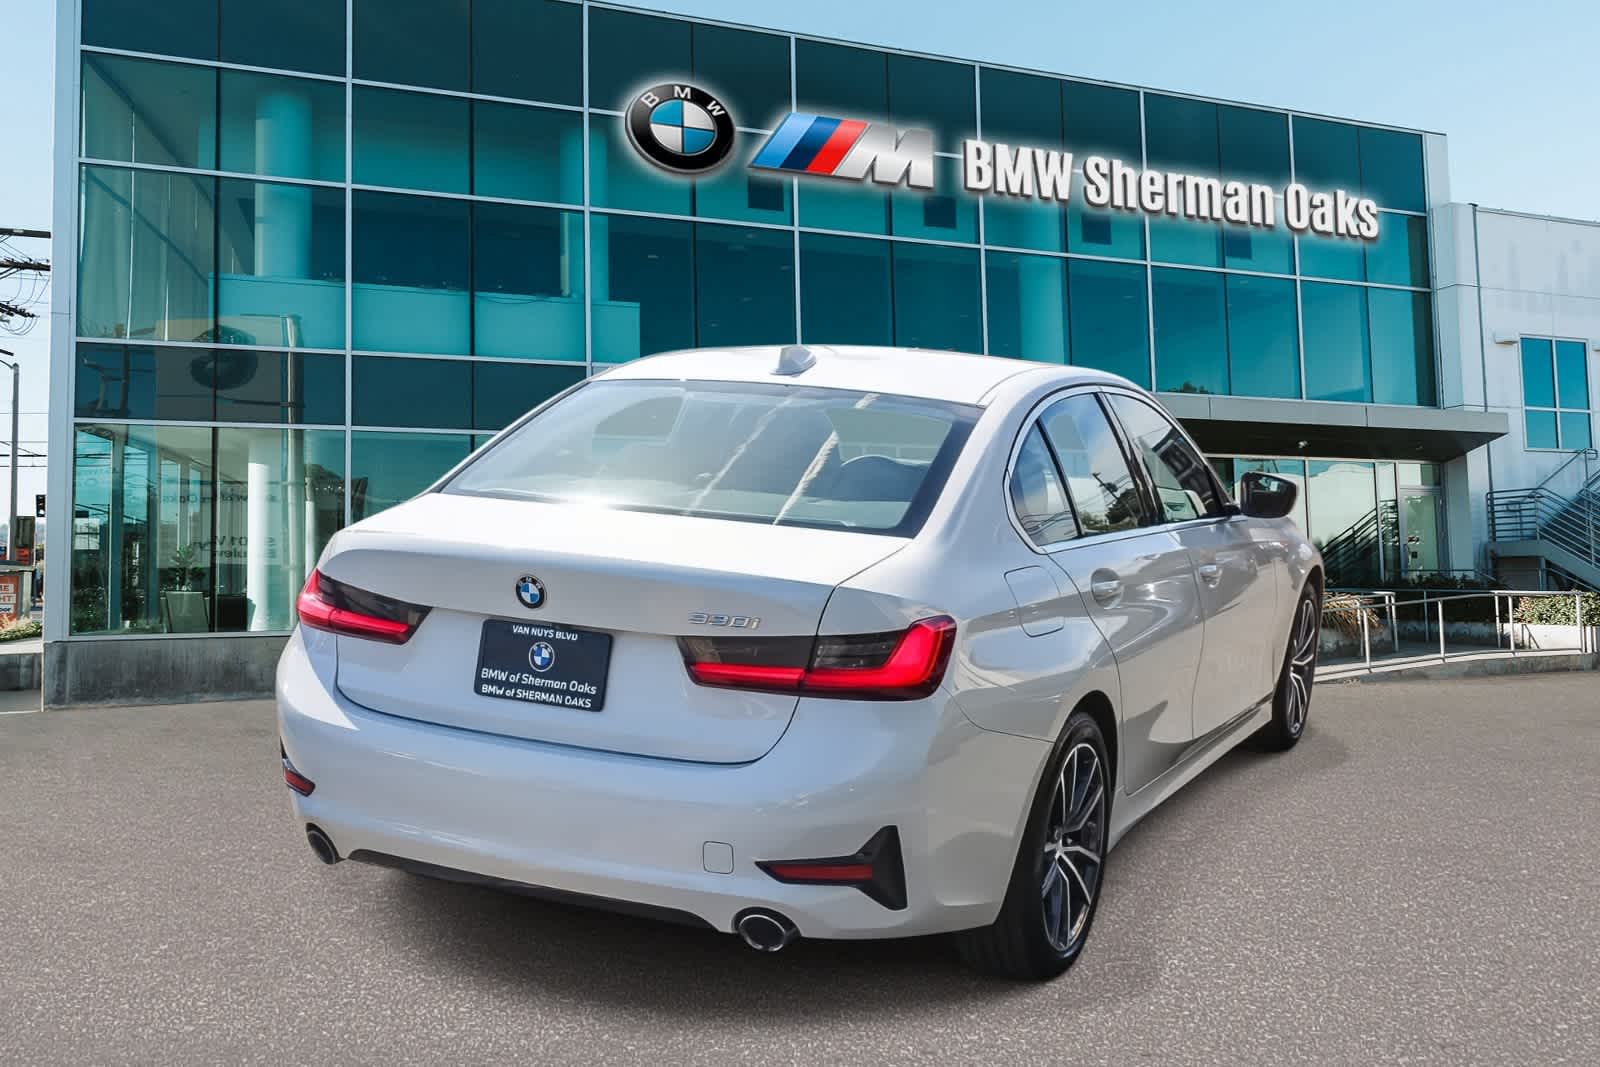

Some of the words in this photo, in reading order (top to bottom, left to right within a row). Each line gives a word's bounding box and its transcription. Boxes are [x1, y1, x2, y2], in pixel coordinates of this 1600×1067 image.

[641, 85, 725, 117] BMW
[964, 139, 1073, 203] BMW
[1083, 156, 1275, 227] Sherman
[1284, 183, 1380, 241] Oaks
[512, 625, 530, 636] VAN
[531, 628, 554, 639] NUYS
[555, 631, 578, 641] BLVD
[481, 668, 508, 682] BMW
[509, 672, 520, 684] of
[521, 673, 567, 691] Sherman
[569, 680, 597, 695] Oaks
[481, 684, 504, 696] BMW
[505, 689, 515, 698] of
[516, 689, 563, 704] SHERMAN
[564, 695, 592, 708] OAKS
